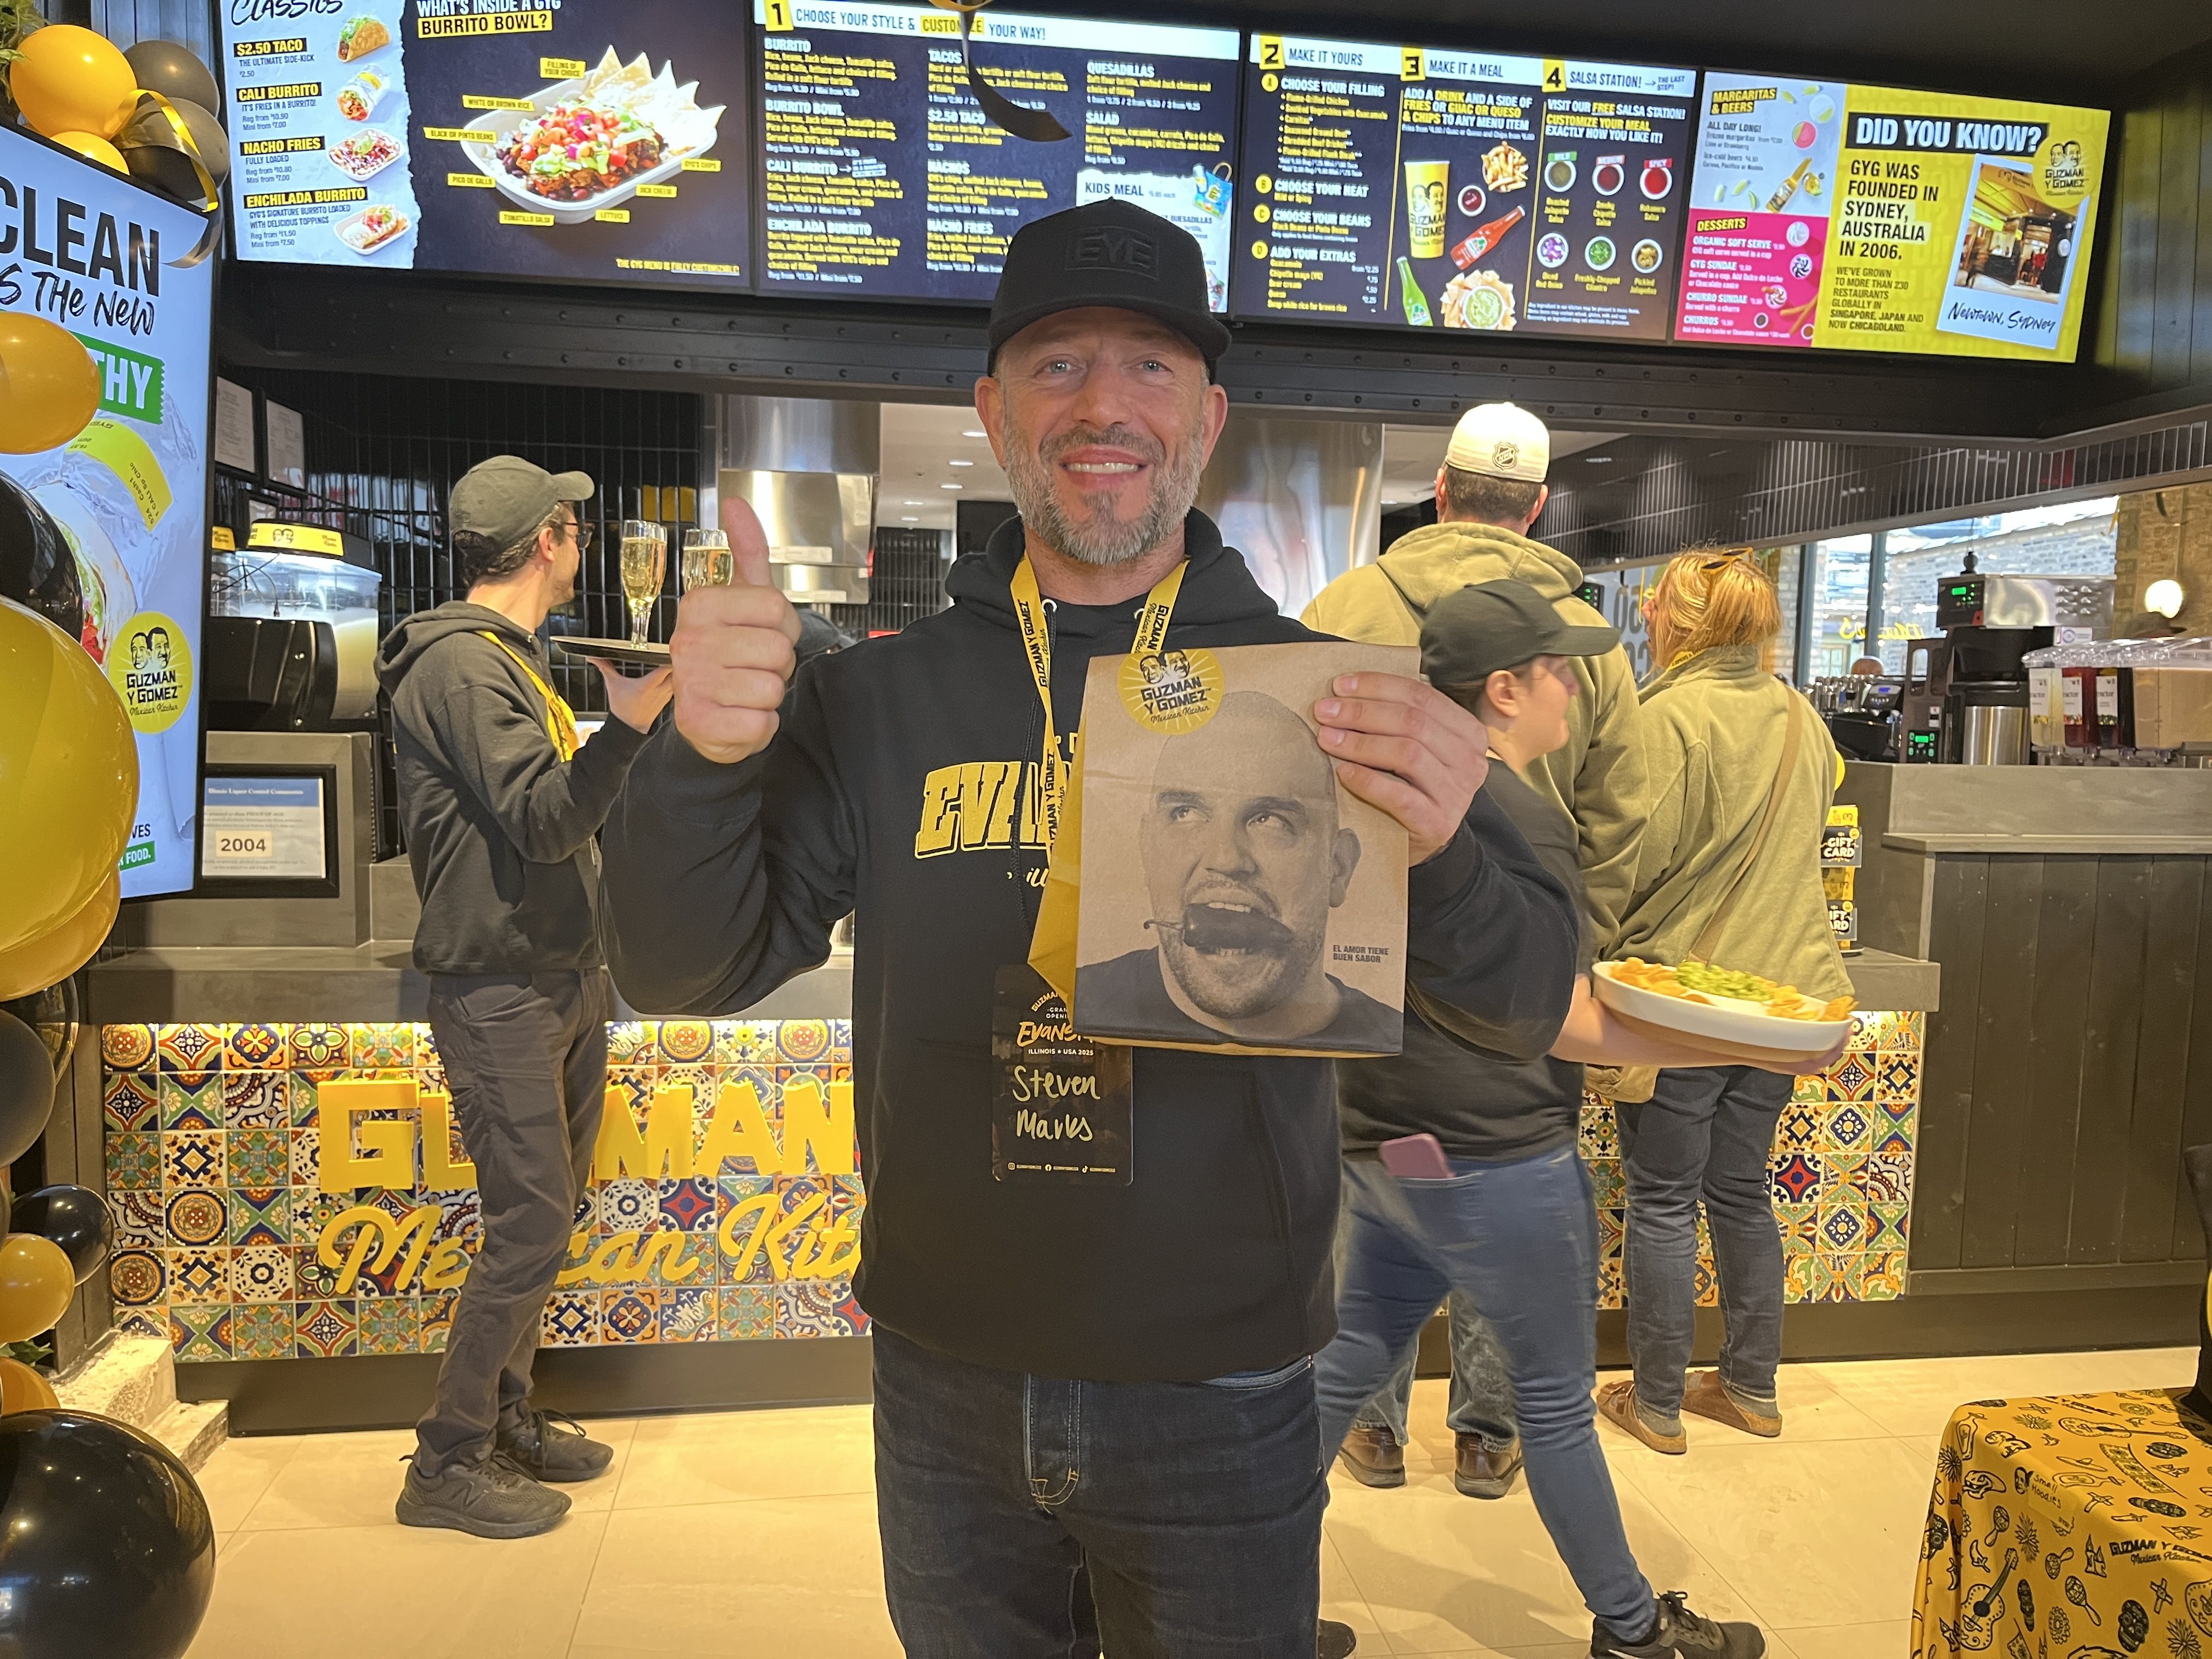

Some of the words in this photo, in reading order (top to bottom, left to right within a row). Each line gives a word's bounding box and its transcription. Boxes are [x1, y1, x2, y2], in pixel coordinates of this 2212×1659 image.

[416, 0, 469, 17] WHAT'S
[473, 0, 518, 14] INSIDE
[422, 17, 488, 35] BURRITO
[494, 14, 548, 31] BOWL?
[771, 3, 782, 25] 1
[796, 9, 836, 24] CHOOSE
[840, 12, 868, 26] YOUR
[872, 15, 904, 29] STYLE
[908, 18, 915, 30] &
[923, 19, 983, 33] CUSTOE
[989, 23, 1017, 38] YOUR
[1020, 26, 1046, 41] WAY!
[237, 42, 271, 57] $2.50
[273, 39, 303, 53] TACO
[764, 38, 811, 53] BURRITO
[284, 54, 314, 63] SIDE-KICK
[928, 49, 962, 64] TACOS
[1265, 43, 1279, 64] 2
[1289, 48, 1315, 62] MAKE
[1319, 50, 1328, 63] IT
[1331, 52, 1363, 66] YOURS
[1086, 61, 1155, 78] QUESADILLAS
[1406, 57, 1419, 76] 3
[1429, 59, 1455, 73] MAKE
[1458, 61, 1467, 75] IT
[1470, 63, 1476, 75] A
[1479, 64, 1504, 77] MEAL
[1547, 67, 1561, 88] 4
[1570, 71, 1597, 84] SALSA
[1599, 74, 1641, 88] STATION!
[238, 88, 266, 101] CALI
[268, 83, 319, 99] BURRITO
[1713, 88, 1776, 103] MARGARITAS
[765, 99, 811, 114] BURRITO
[812, 102, 845, 116] BOWL
[1711, 104, 1719, 115] &
[1721, 101, 1754, 114] BEERS
[1086, 111, 1120, 126] SALAD
[1856, 117, 1898, 145] DID
[1904, 119, 1951, 149] YOU
[1955, 122, 2042, 153] KNOW?
[244, 140, 284, 155] NACHO
[287, 138, 321, 151] FRIES
[246, 156, 263, 165] FULLY
[266, 155, 289, 163] LOADED
[766, 159, 791, 173] CALI
[792, 160, 839, 176] BURRITO
[1850, 159, 1881, 177] GYG
[1886, 162, 1920, 179] WAS
[2045, 168, 2084, 178] GUZMAN
[1085, 182, 1110, 194] KIDS
[1114, 184, 1144, 196] MEAL
[1848, 180, 1917, 201] FOUNDED
[1923, 185, 1939, 202] IN
[2045, 179, 2051, 188] Y
[2053, 178, 2084, 188] GOMEZ
[247, 191, 313, 208] ENCHILADA
[315, 188, 365, 203] BURRITO
[1844, 201, 1909, 221] SYDNEY,
[1697, 218, 1747, 232] DESSERTS
[1842, 221, 1925, 241] AUSTRALIA
[1077, 233, 1152, 269] EYE
[1839, 240, 1854, 257] IN
[1860, 242, 1903, 259] 2006.
[1837, 267, 1860, 276] WE'VE
[1863, 268, 1892, 278] GROWN
[1835, 277, 1846, 286] TO
[1847, 278, 1870, 288] MORE
[1872, 279, 1892, 289] THAN
[1833, 288, 1889, 300] RESTAURANTS
[1832, 299, 1871, 309] GLOBALLY
[1874, 301, 1882, 309] IN
[1829, 320, 1847, 329] NOW
[1879, 312, 1905, 321] JAPAN
[1907, 313, 1923, 323] AND
[1018, 599, 1035, 636] GOMEZ
[1147, 605, 1169, 651] GUZMAN
[1029, 643, 1048, 688] GUZMAN
[127, 670, 176, 689] GUZMAN
[127, 691, 135, 706] Y
[138, 686, 178, 703] GOMEZ
[1141, 676, 1202, 702] GUZMAN
[1144, 702, 1154, 714] Y
[1156, 690, 1207, 712] GOMEZ
[1150, 713, 1182, 724] Mexican
[1182, 705, 1210, 716] Kitchen
[1045, 748, 1056, 793] GOMEZ
[1046, 793, 1055, 803] Y
[221, 838, 266, 852] 2004
[1827, 837, 1854, 848] GIFT
[126, 848, 151, 862] FOOD.
[1824, 847, 1855, 858] CARD
[1829, 910, 1847, 921] IFT
[1830, 920, 1849, 931] ARD
[1333, 953, 1353, 961] BUEN
[1355, 954, 1381, 963] SABOR
[1368, 947, 1389, 955] TIENE
[1012, 1065, 1101, 1102] Steven
[318, 1079, 854, 1193] GUMAN
[2034, 1475, 2057, 1493] Small
[2032, 1484, 2061, 1509] Hoodies
[2109, 1539, 2157, 1556] GUZMAN
[2161, 1542, 2172, 1550] Y
